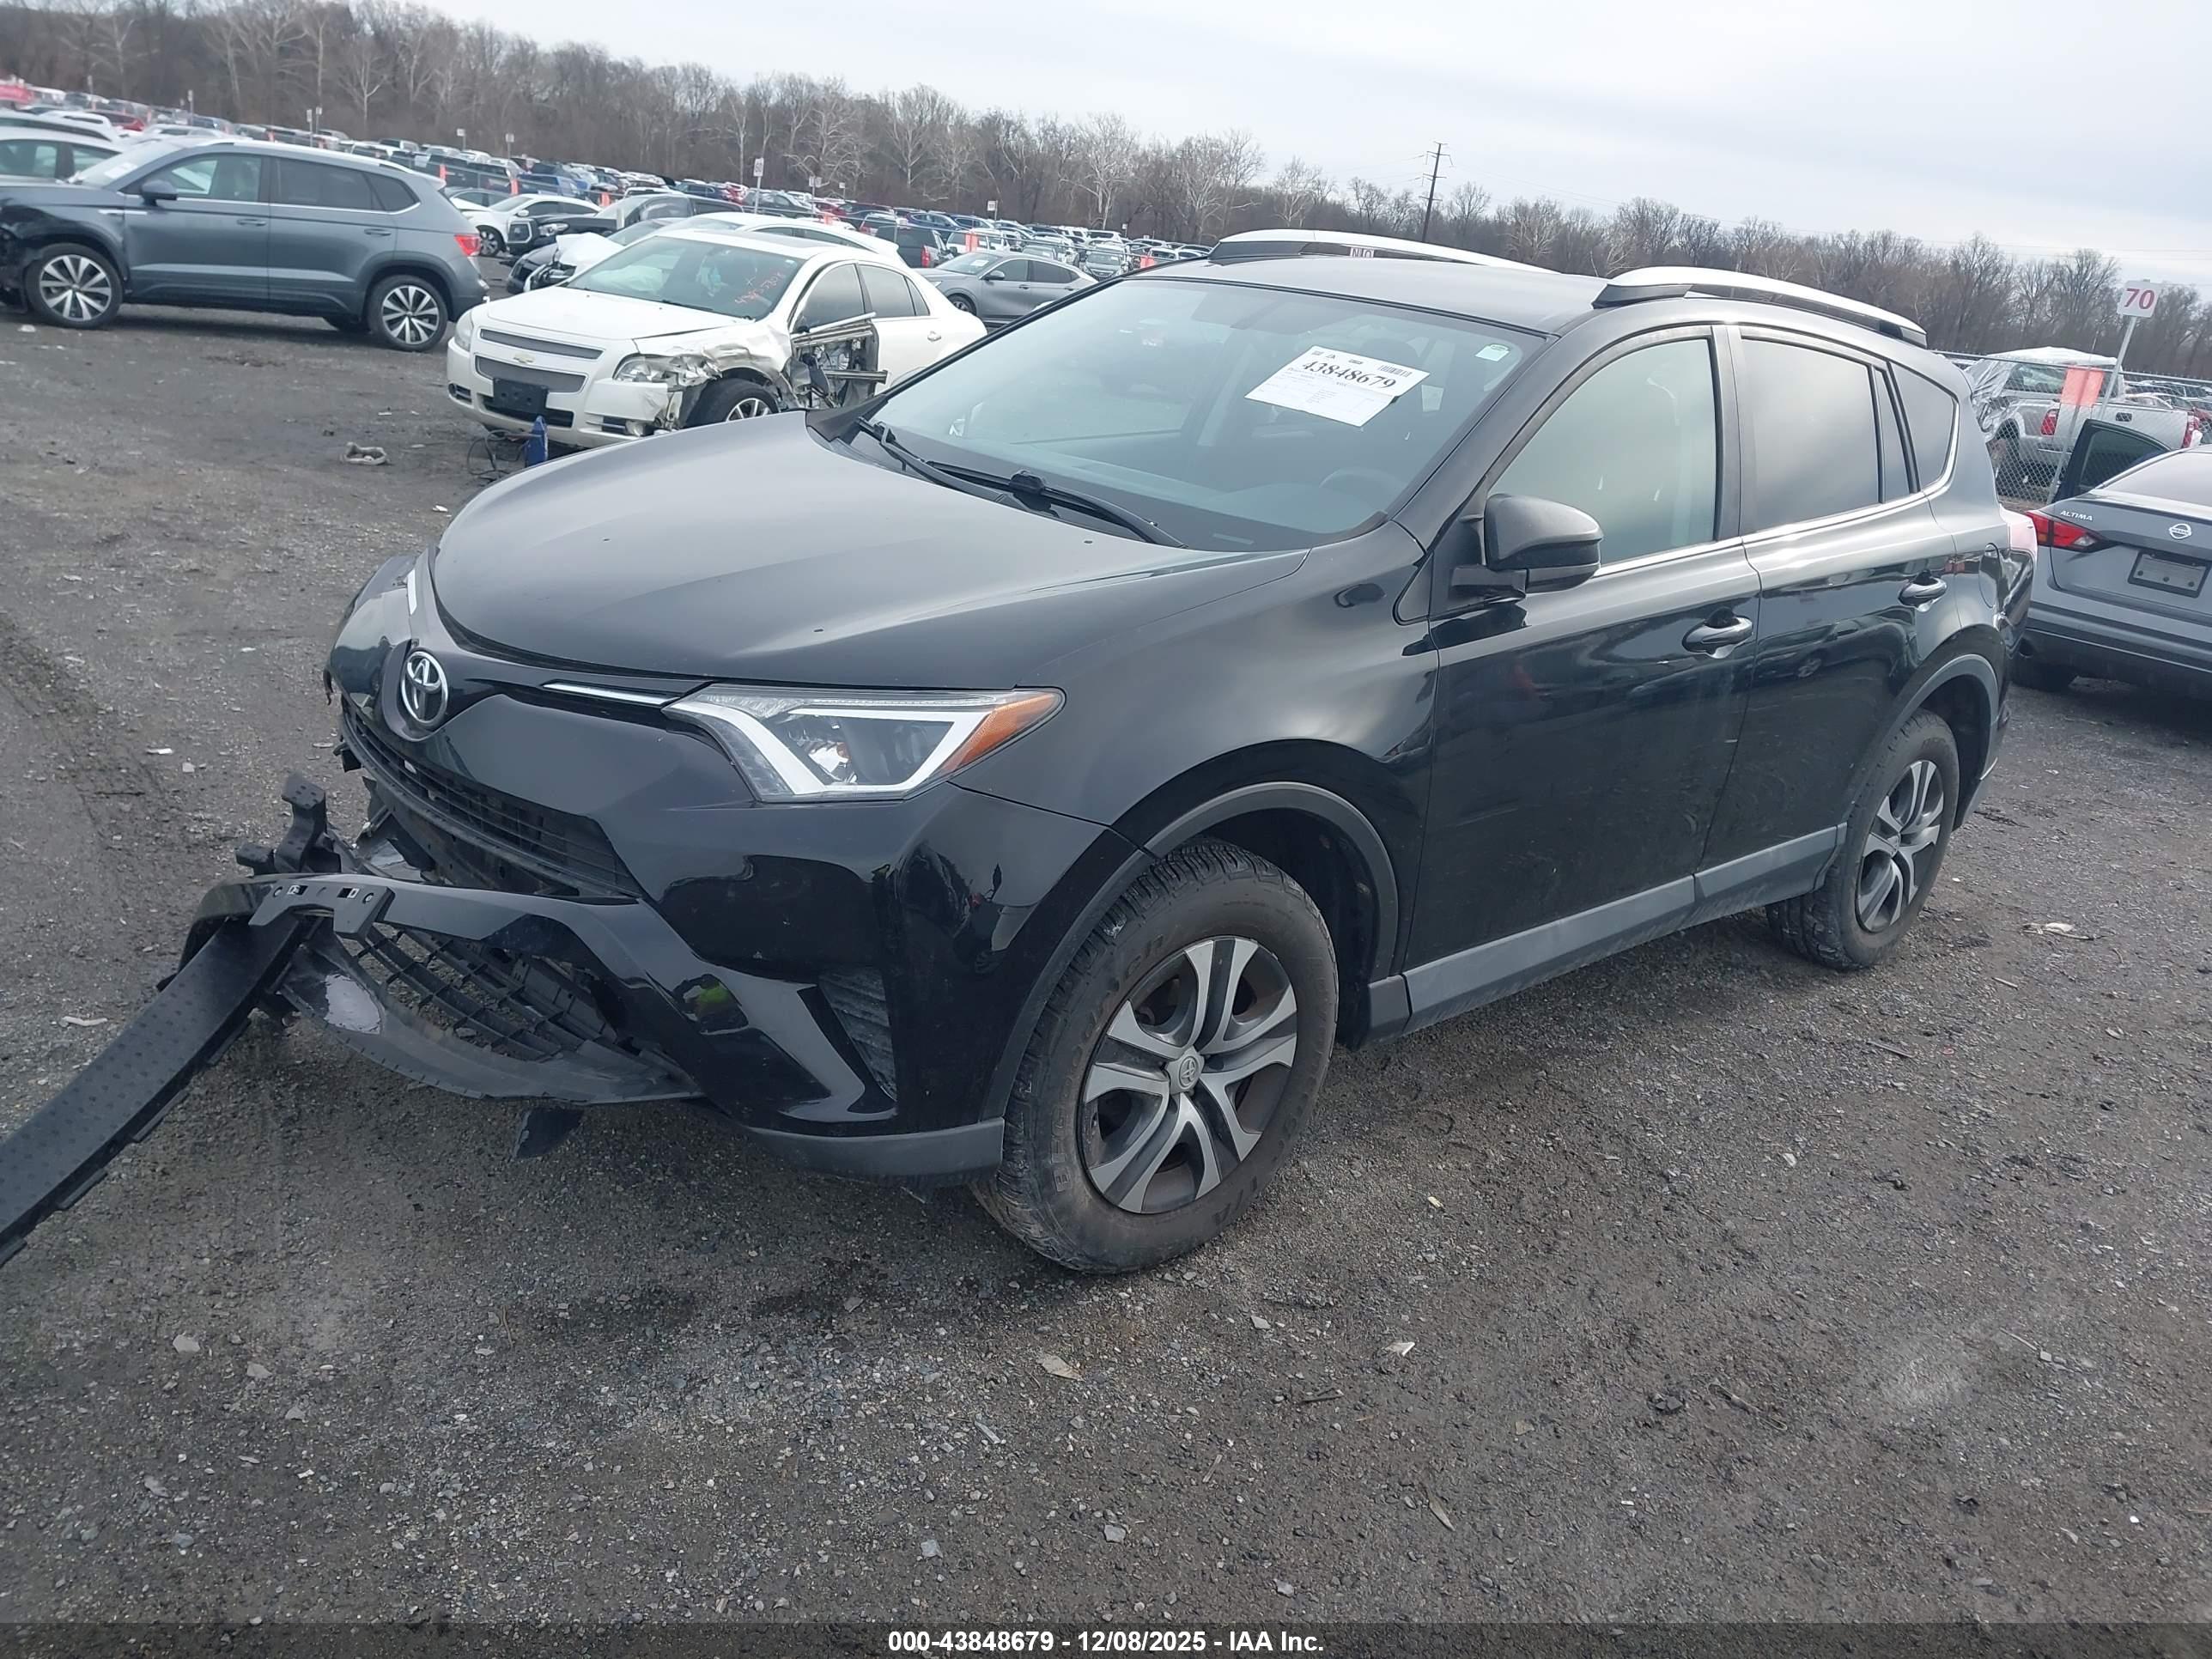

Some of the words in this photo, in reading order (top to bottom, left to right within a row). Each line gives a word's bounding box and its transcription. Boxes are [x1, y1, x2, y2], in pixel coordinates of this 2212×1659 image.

[2124, 288, 2155, 310] 70
[1303, 360, 1397, 389] 43848679
[2060, 510, 2093, 521] ALTIMA
